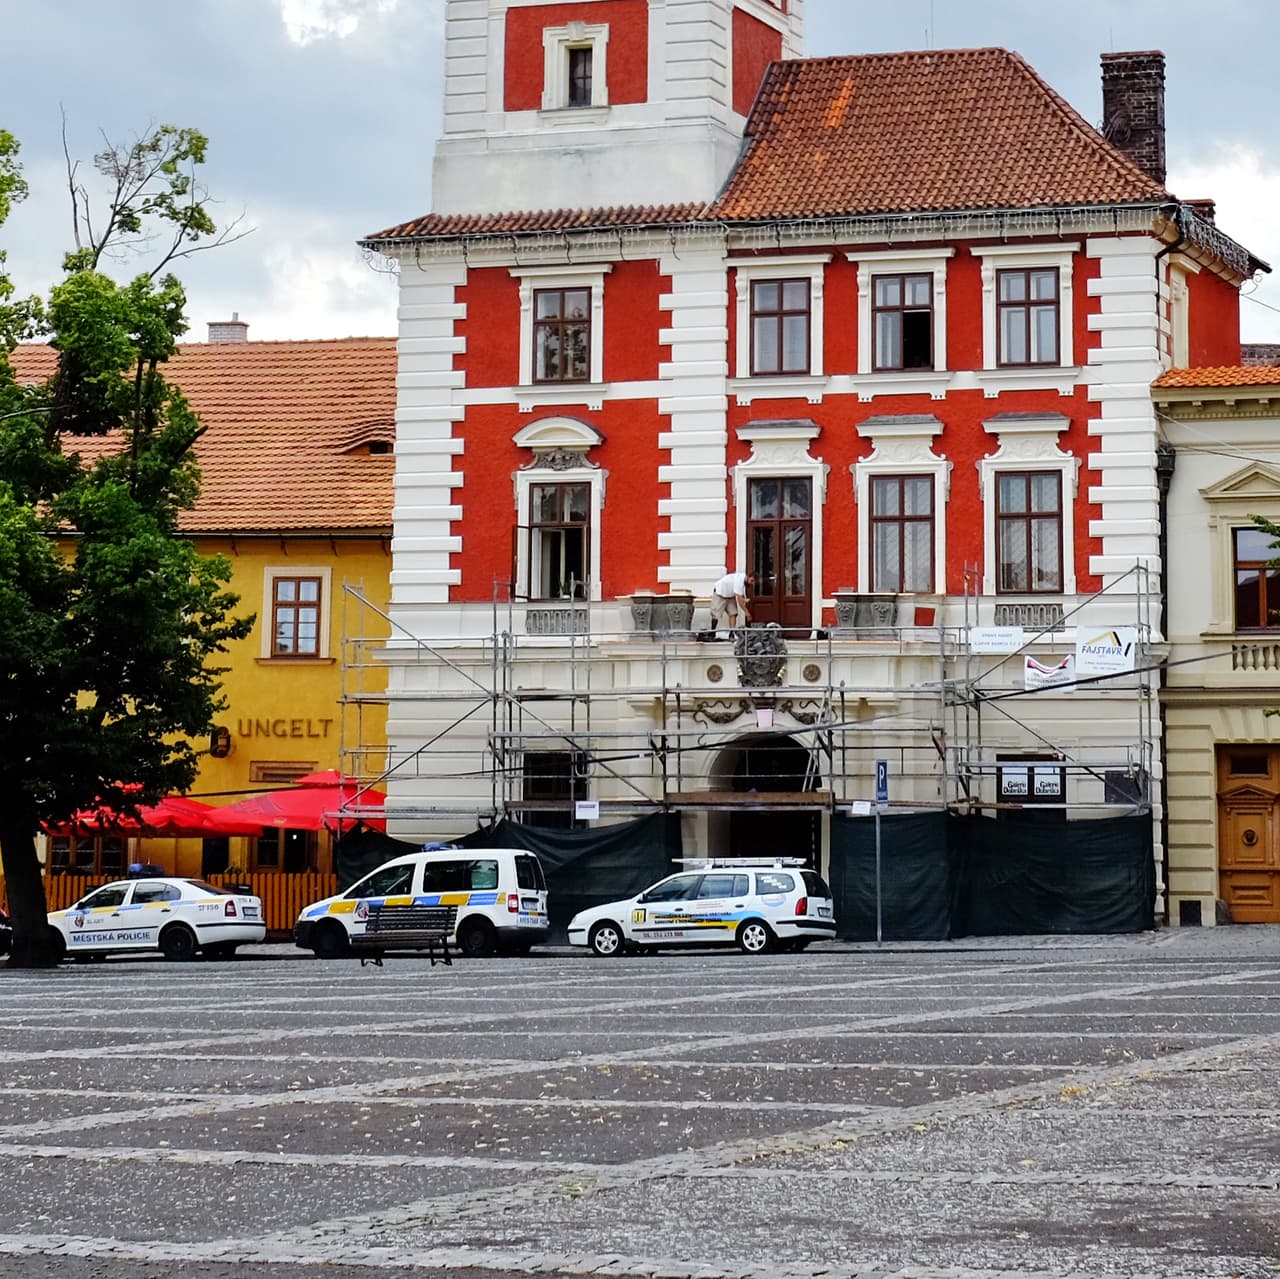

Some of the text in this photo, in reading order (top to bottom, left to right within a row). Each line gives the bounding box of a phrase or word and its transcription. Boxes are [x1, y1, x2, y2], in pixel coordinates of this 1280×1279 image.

[237, 718, 333, 738] UNGELT
[879, 765, 885, 788] P
[117, 931, 151, 941] POLICIE
